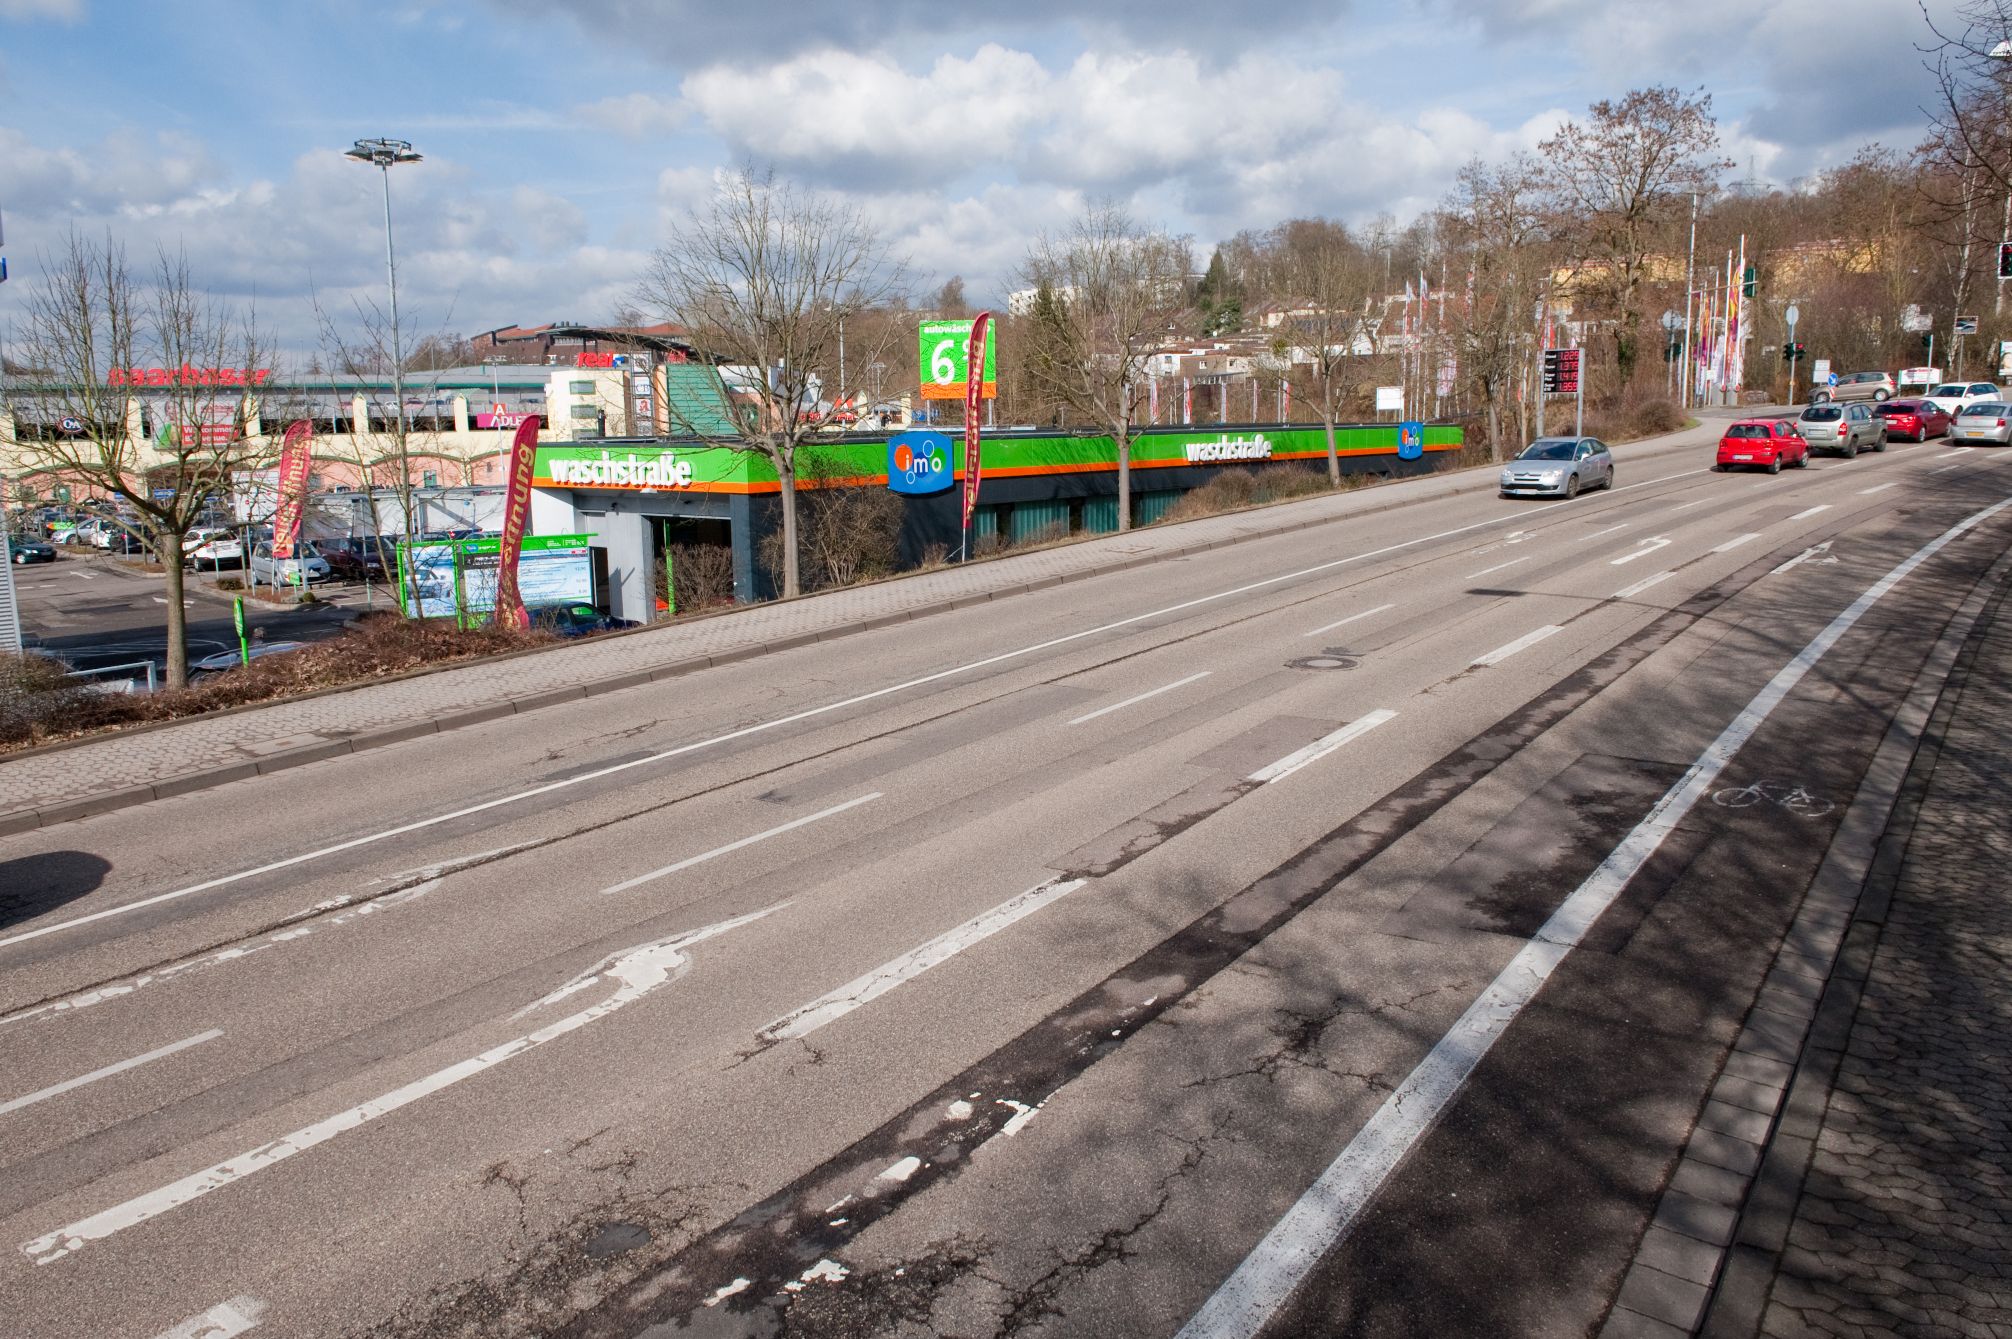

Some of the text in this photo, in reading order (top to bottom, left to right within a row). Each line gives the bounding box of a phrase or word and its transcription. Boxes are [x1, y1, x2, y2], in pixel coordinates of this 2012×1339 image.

[924, 323, 972, 333] autowäsch
[931, 340, 955, 385] 6
[1185, 434, 1272, 461] waschstraße
[549, 450, 692, 487] waschstraße
[905, 453, 942, 473] imo
